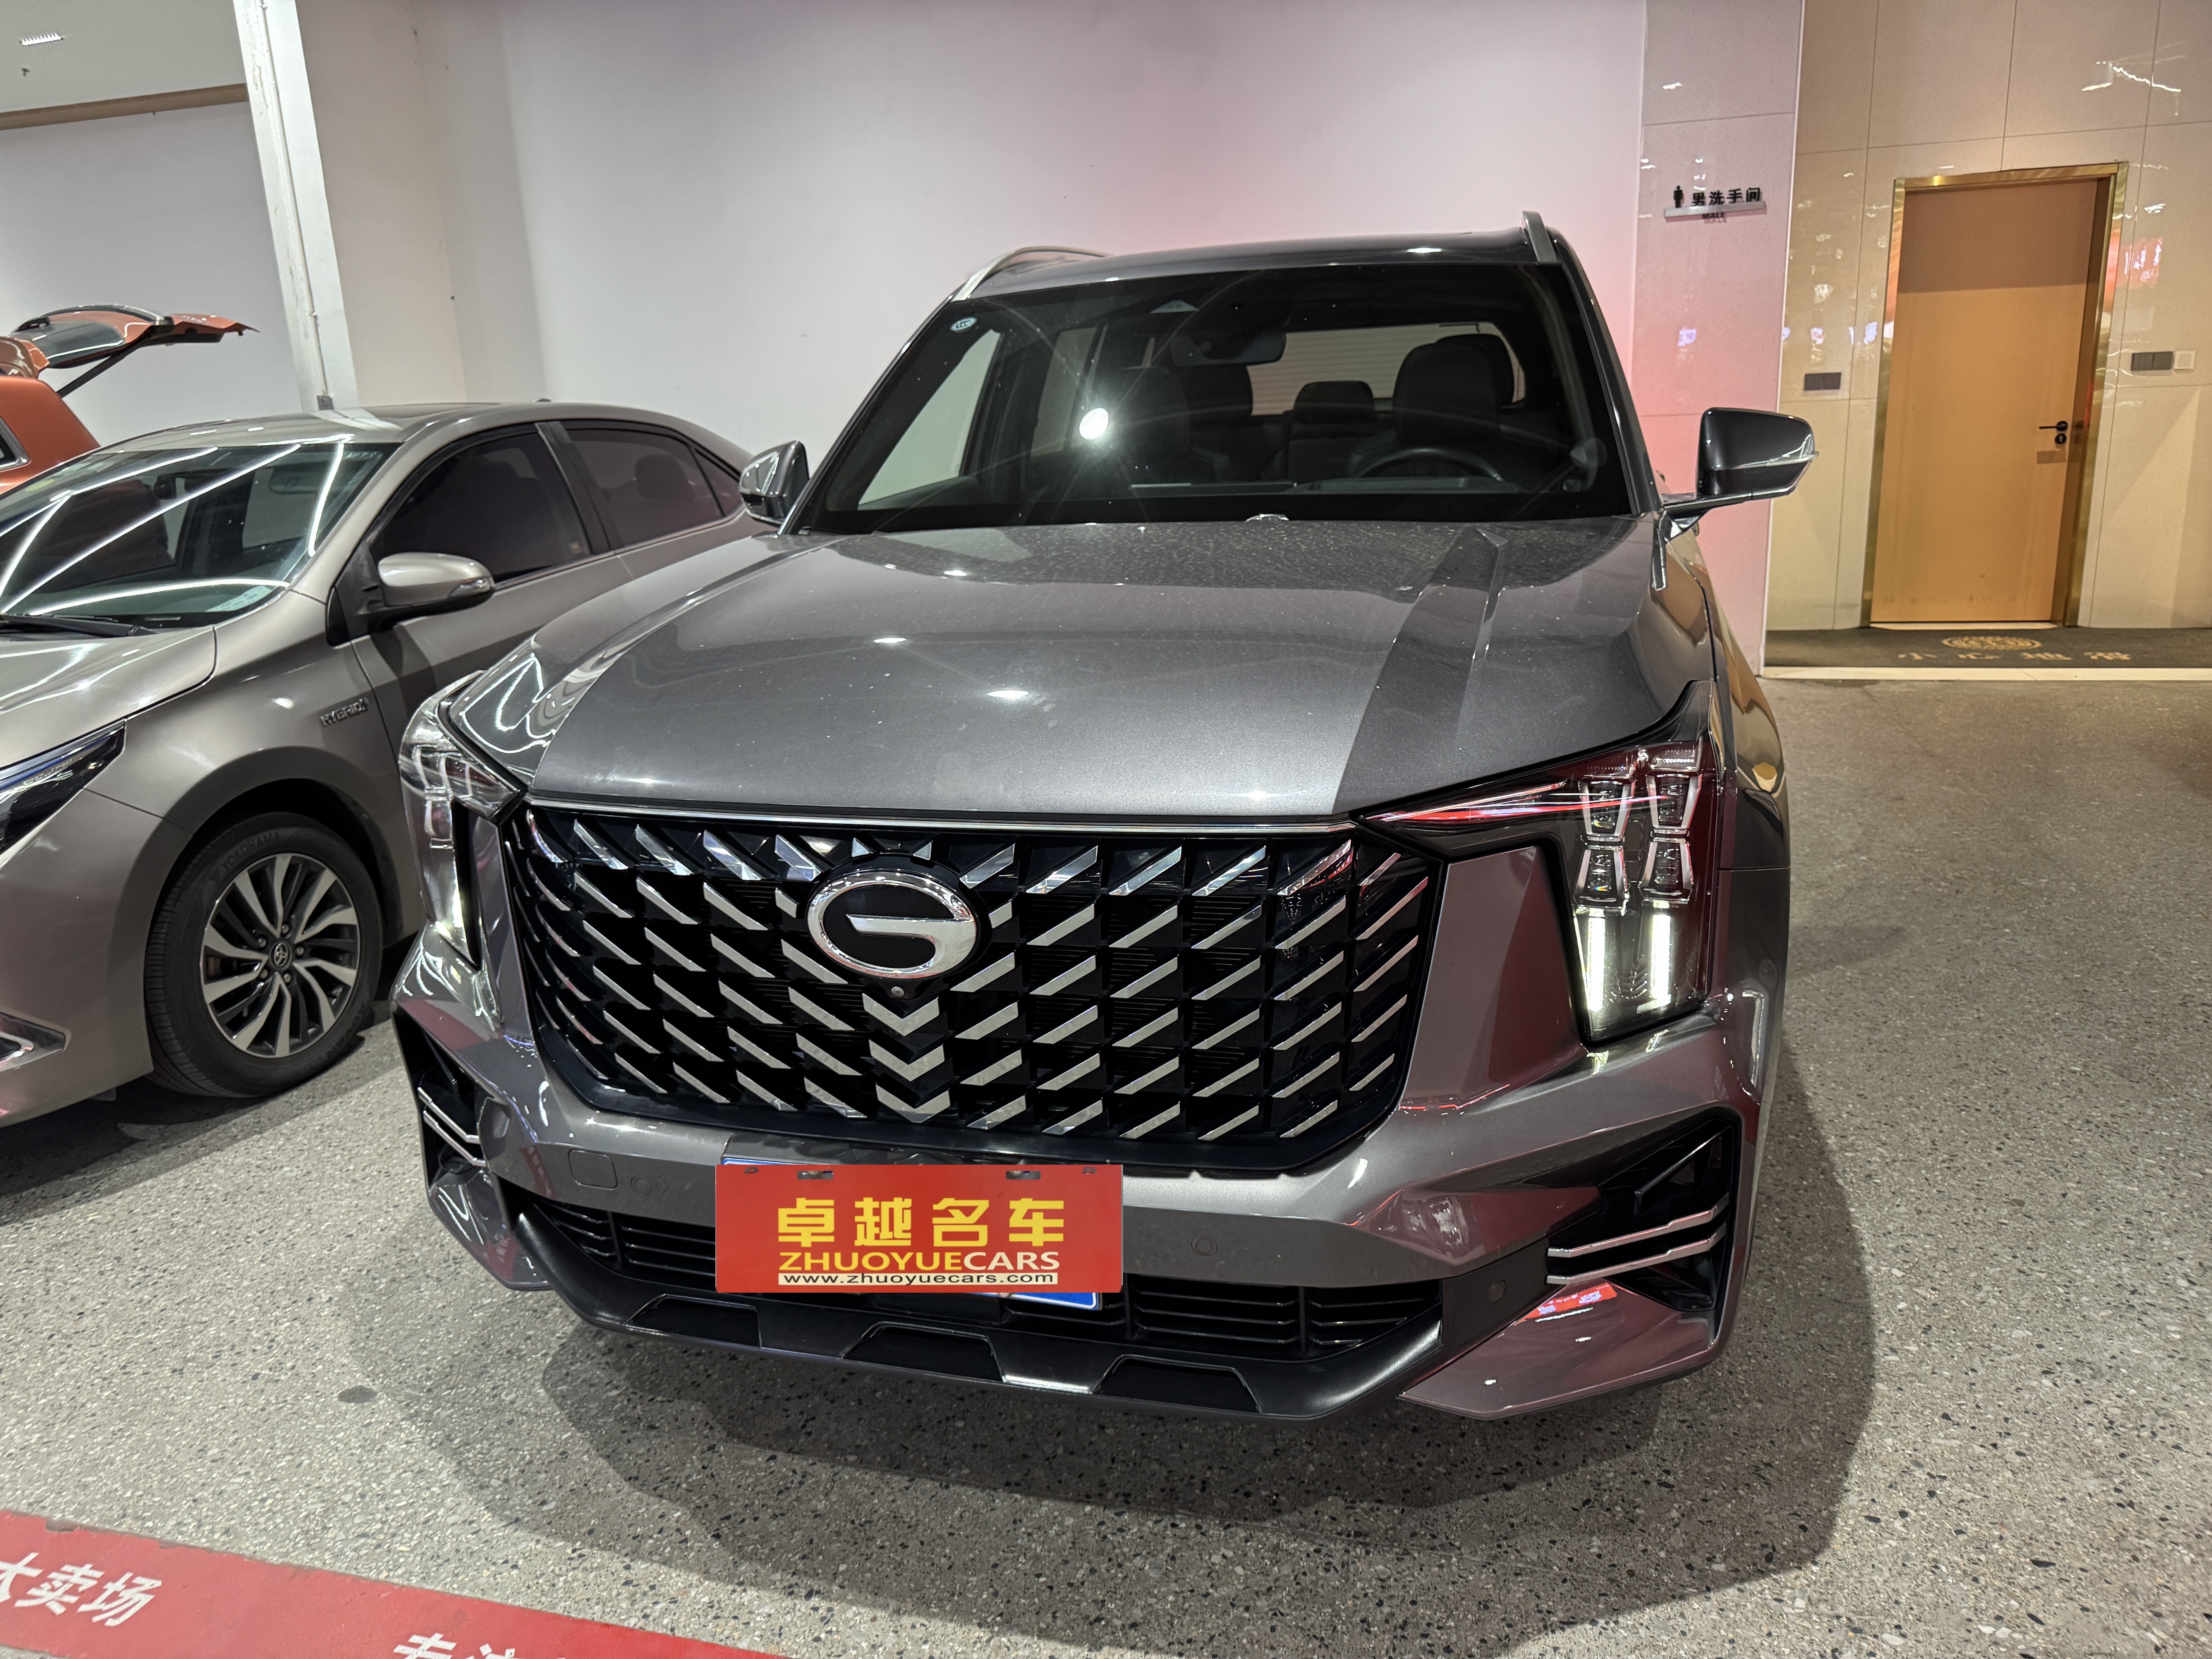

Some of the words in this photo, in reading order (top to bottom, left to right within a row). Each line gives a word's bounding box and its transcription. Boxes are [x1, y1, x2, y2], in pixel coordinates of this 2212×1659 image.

[1691, 187, 1761, 206] 男洗手间
[220, 831, 282, 869] YOKOHAMA
[778, 1197, 1064, 1247] 卓越名车
[779, 1252, 1060, 1271] ZHUOYUECARS
[784, 1273, 1053, 1285] www.zhuoyuecars.com
